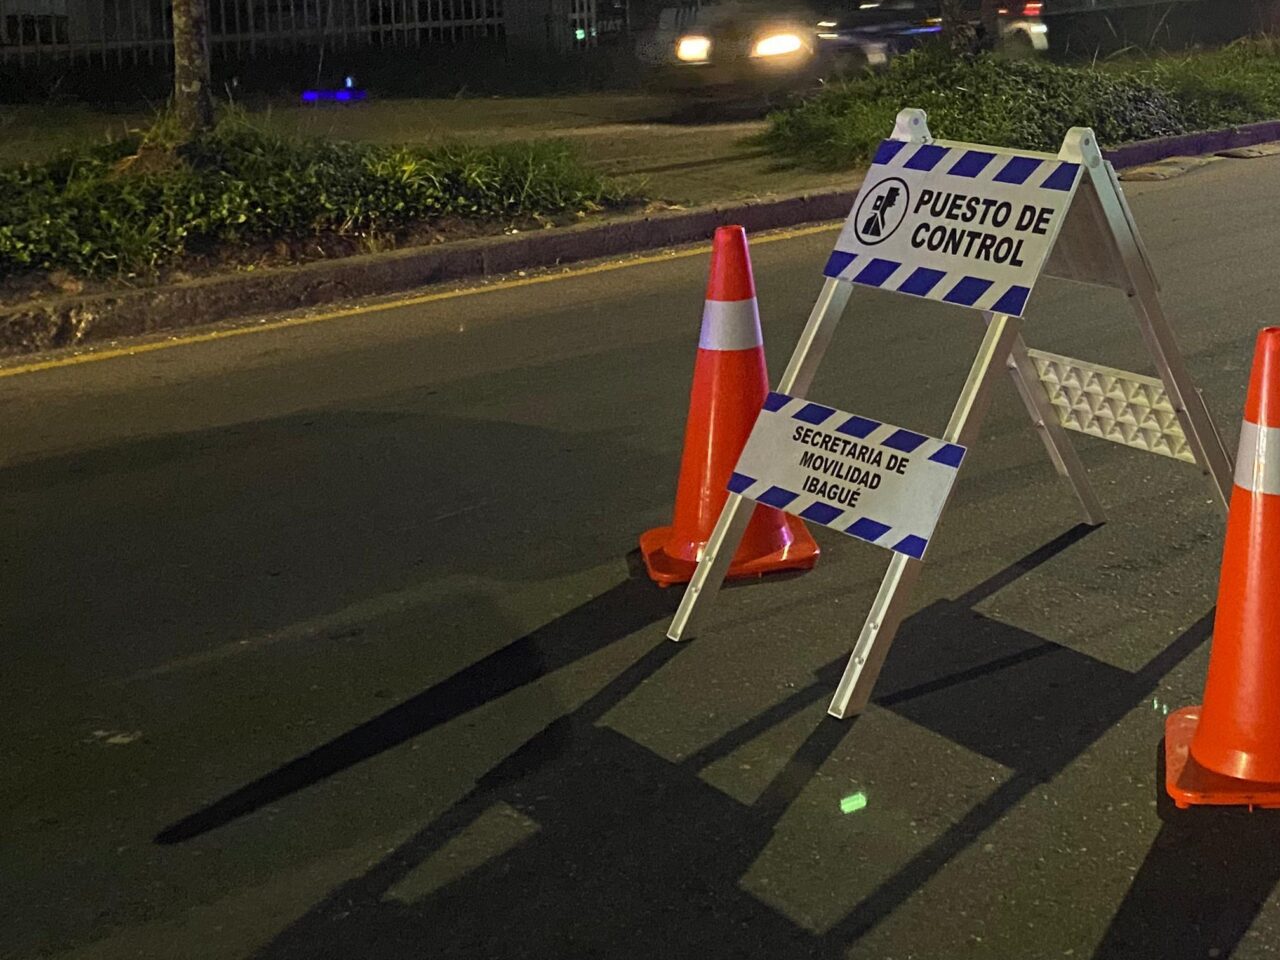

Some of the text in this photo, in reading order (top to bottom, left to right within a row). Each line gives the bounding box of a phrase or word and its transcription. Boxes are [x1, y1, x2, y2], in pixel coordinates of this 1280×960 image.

[913, 189, 1055, 235] PUESTO DE
[911, 222, 1024, 267] CONTROL
[792, 425, 909, 475] SECRETARIA DE
[799, 451, 881, 490] MOVILIDAD
[802, 475, 861, 508] IBAGUÉ
